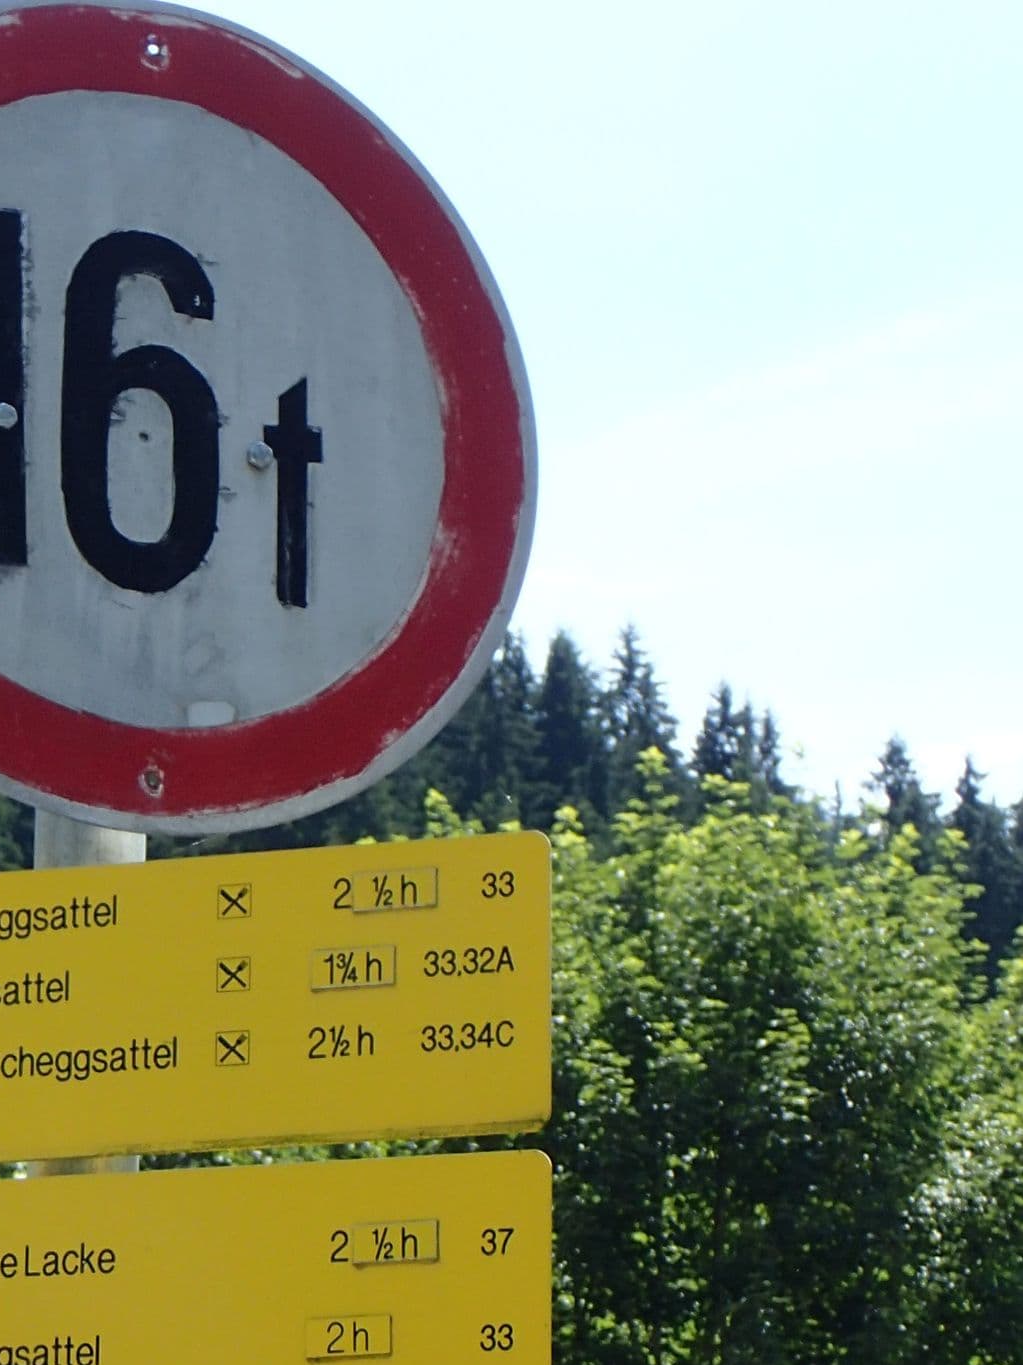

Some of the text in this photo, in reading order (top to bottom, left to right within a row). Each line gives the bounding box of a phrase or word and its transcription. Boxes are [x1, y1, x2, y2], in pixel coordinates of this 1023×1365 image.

[263, 377, 323, 609] t
[481, 870, 515, 898] 33
[481, 1228, 514, 1256] 37
[24, 1242, 116, 1278] Lacke
[480, 1324, 513, 1351] 33
